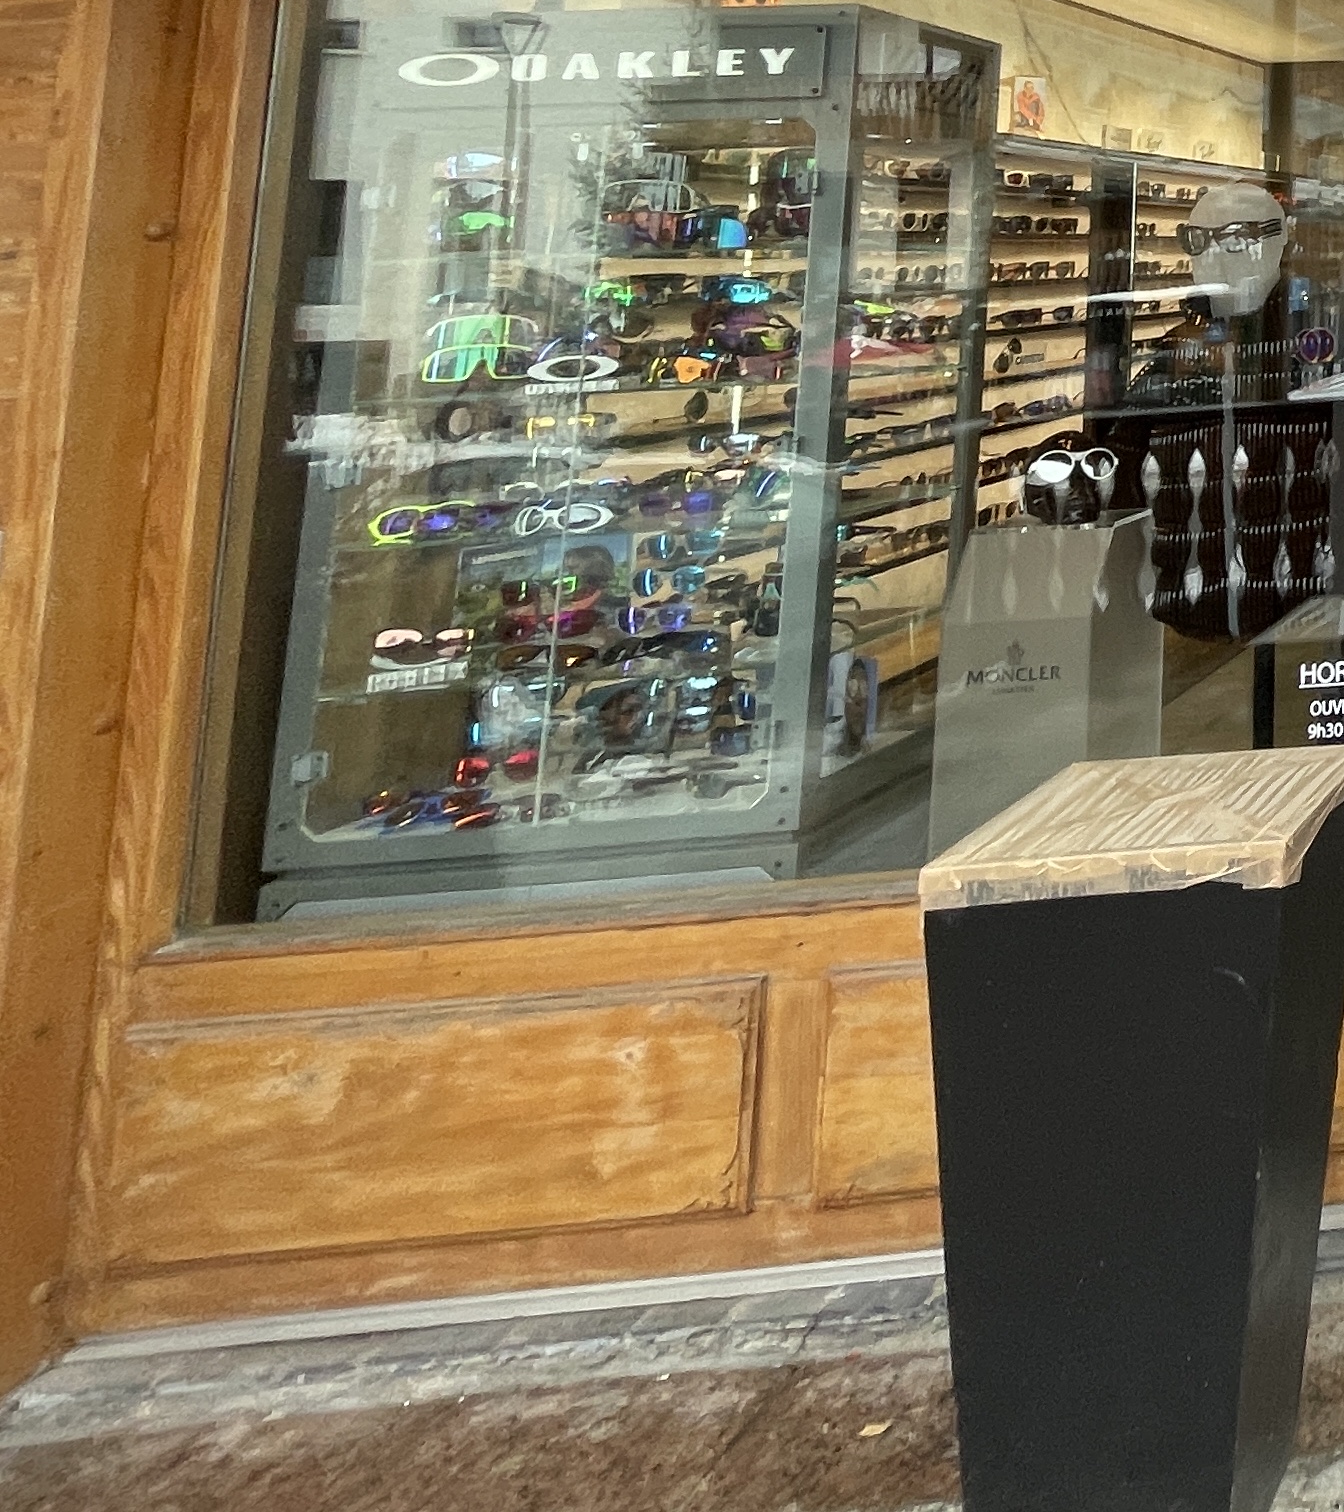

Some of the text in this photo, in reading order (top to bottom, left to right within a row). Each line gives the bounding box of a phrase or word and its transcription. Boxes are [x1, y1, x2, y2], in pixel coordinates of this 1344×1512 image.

[510, 46, 796, 83] OAKLEY
[966, 665, 1062, 687] MONCLER
[1307, 722, 1343, 739] 9h30
